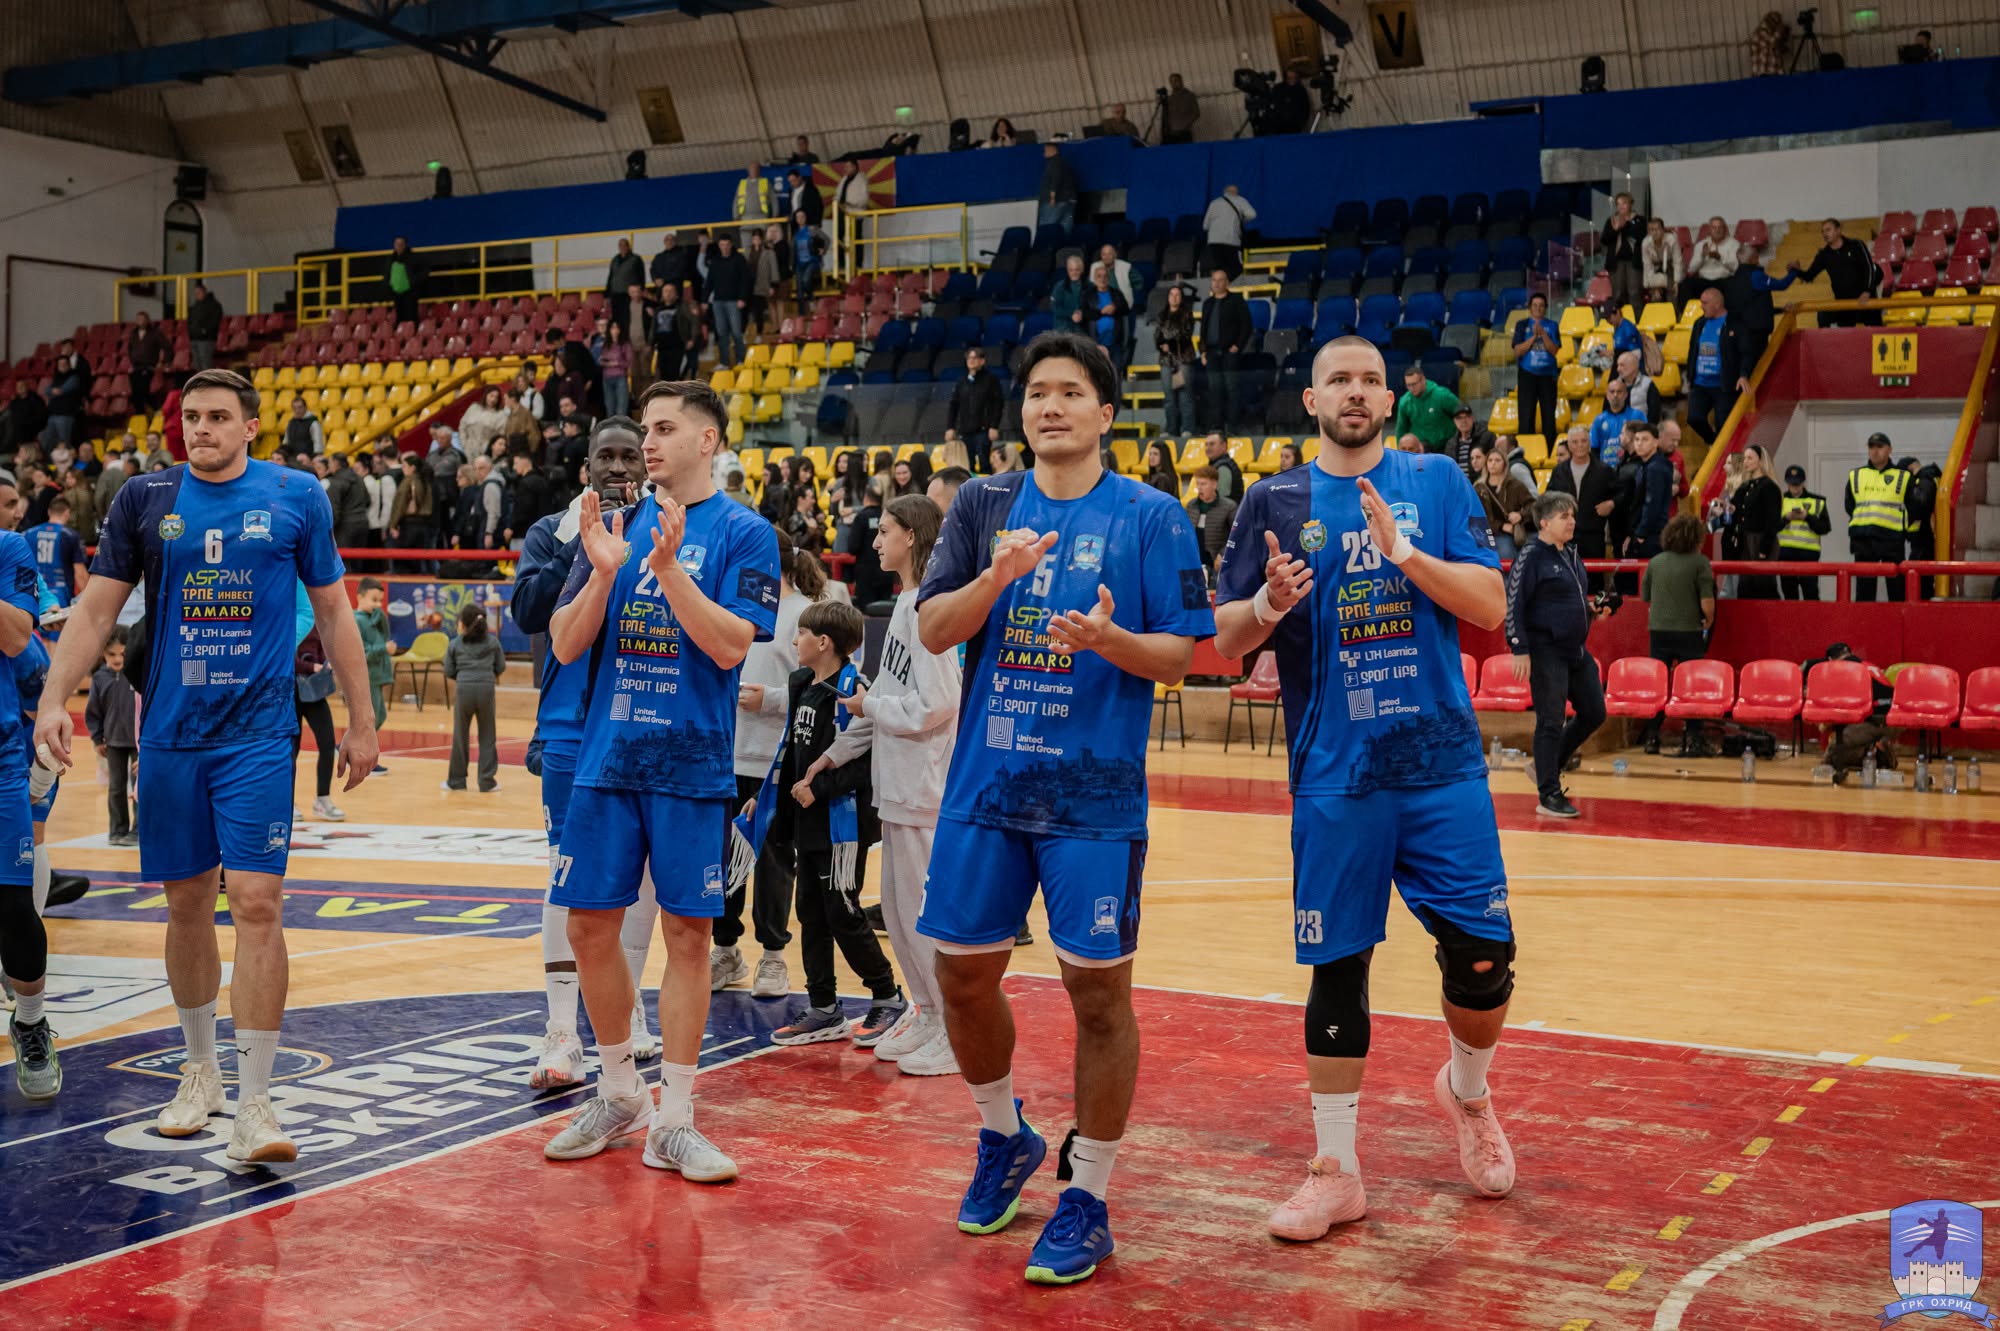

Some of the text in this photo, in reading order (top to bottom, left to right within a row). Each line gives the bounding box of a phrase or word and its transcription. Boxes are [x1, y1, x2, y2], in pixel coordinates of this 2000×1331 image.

[205, 529, 223, 564] 6
[1341, 529, 1382, 574] 23
[184, 569, 253, 586] ASPPAK
[634, 557, 664, 598] 2
[182, 588, 253, 600] ТРПЕ ИНВЕСТ
[1337, 576, 1409, 603] ASPPAK
[183, 605, 252, 617] TAMARO
[1337, 601, 1412, 621] ТРПЕ ИНВЕСТ
[619, 619, 646, 633] ТРПЕ
[1340, 619, 1412, 641] TAMARO
[202, 628, 218, 638] LTH
[1004, 626, 1033, 644] РПЕ
[882, 631, 912, 686] NIA
[1365, 649, 1382, 661] LTH
[630, 661, 647, 673] LTH
[210, 677, 249, 685] Build Group
[1013, 679, 1031, 691] LTH
[634, 707, 657, 716] United
[1395, 705, 1420, 714] Group
[633, 714, 672, 726] Build Group
[1016, 734, 1043, 744] United
[1015, 743, 1064, 756] Build Group
[1297, 909, 1323, 944] 23
